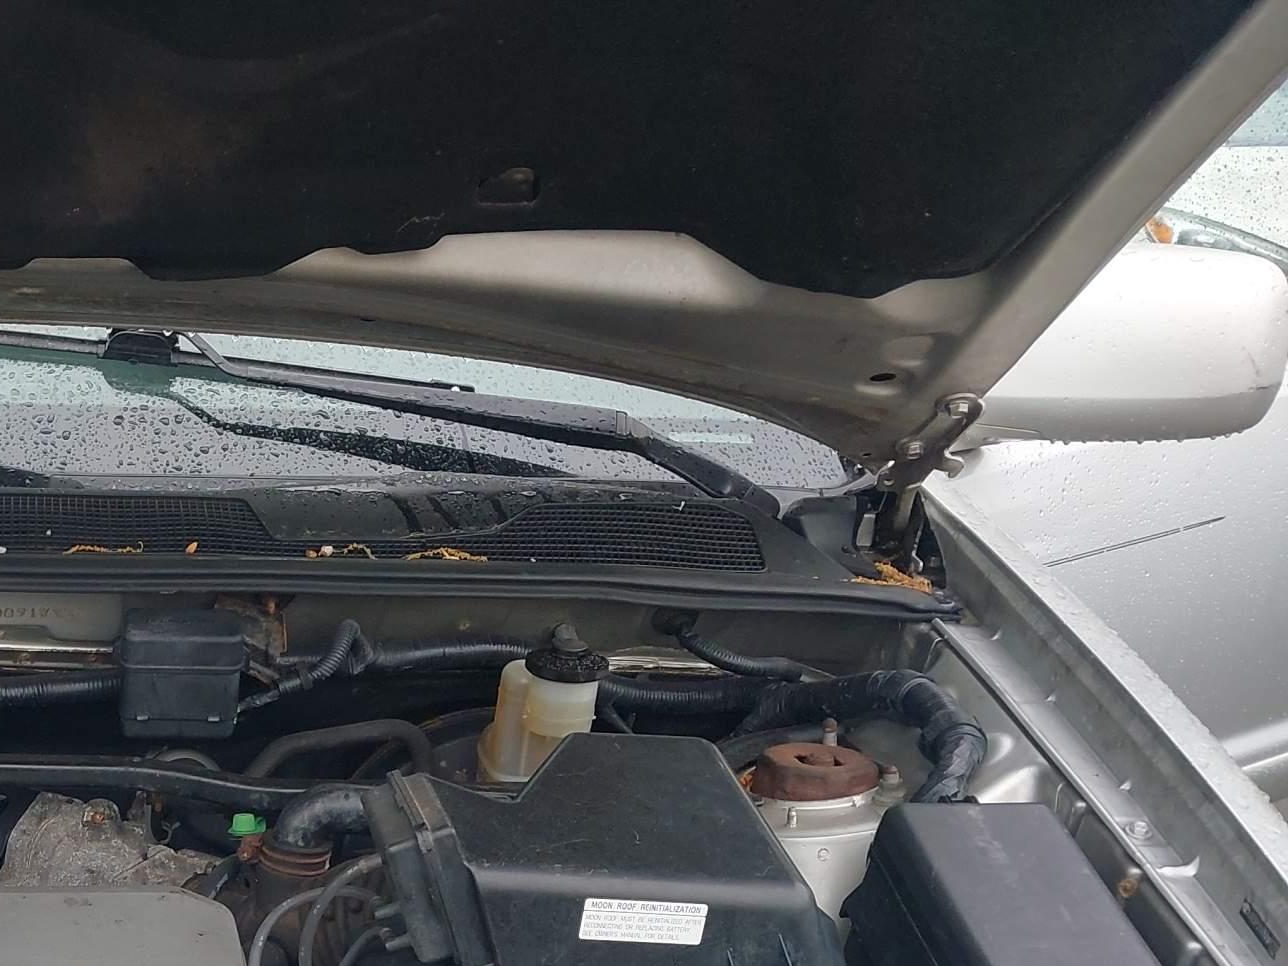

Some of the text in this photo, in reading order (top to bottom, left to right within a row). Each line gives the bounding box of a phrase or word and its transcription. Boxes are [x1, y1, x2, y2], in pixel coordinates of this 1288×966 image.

[591, 901, 701, 913] MOON ROOF REINITIALIZATION
